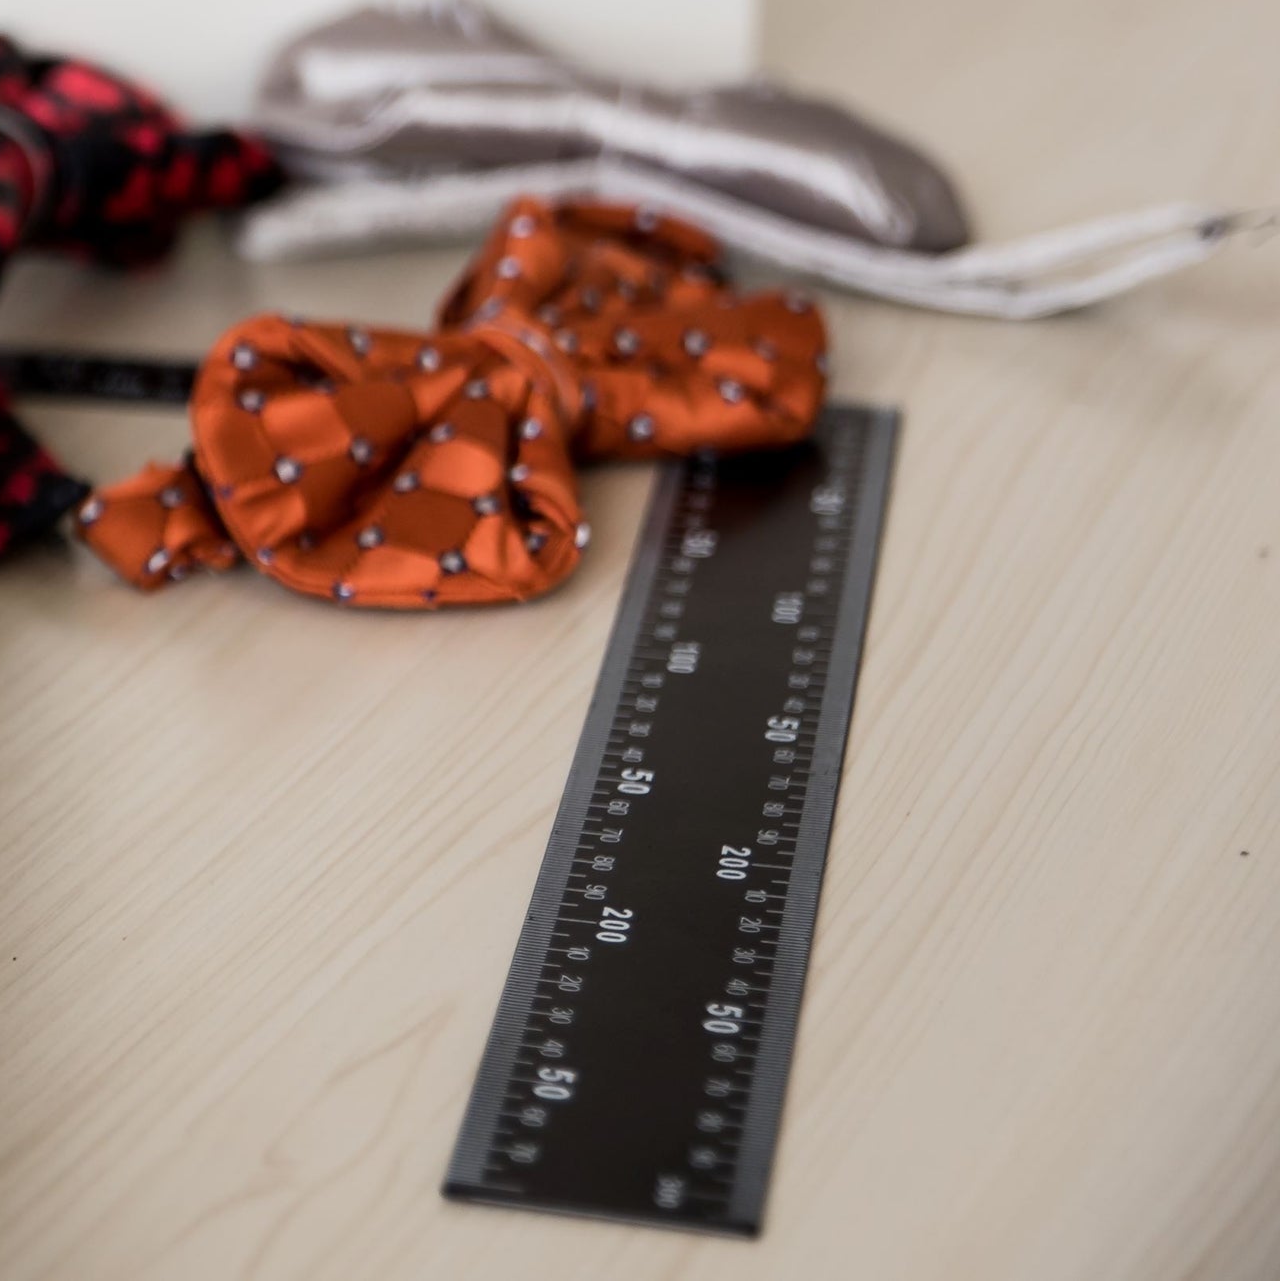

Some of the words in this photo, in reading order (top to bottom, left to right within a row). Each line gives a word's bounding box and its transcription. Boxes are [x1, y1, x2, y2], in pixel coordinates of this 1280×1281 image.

[667, 641, 701, 674] 100
[765, 715, 801, 743] 50
[617, 767, 654, 795] 50
[769, 776, 790, 791] 70
[609, 800, 630, 816] 60
[763, 802, 784, 817] 80
[601, 828, 623, 843] 70
[757, 829, 778, 846] 90
[593, 856, 615, 871] 80
[716, 844, 752, 881] 200
[585, 885, 607, 901] 90
[745, 890, 766, 903] 10
[596, 906, 633, 943] 200
[740, 917, 761, 933] 20
[568, 947, 590, 961] 10
[733, 948, 754, 964] 30
[559, 975, 582, 993] 20
[727, 979, 749, 996] 40
[550, 1007, 574, 1025] 30
[703, 1003, 743, 1034] 50
[541, 1040, 564, 1058] 40
[713, 1045, 736, 1063] 60
[533, 1067, 575, 1101] 50
